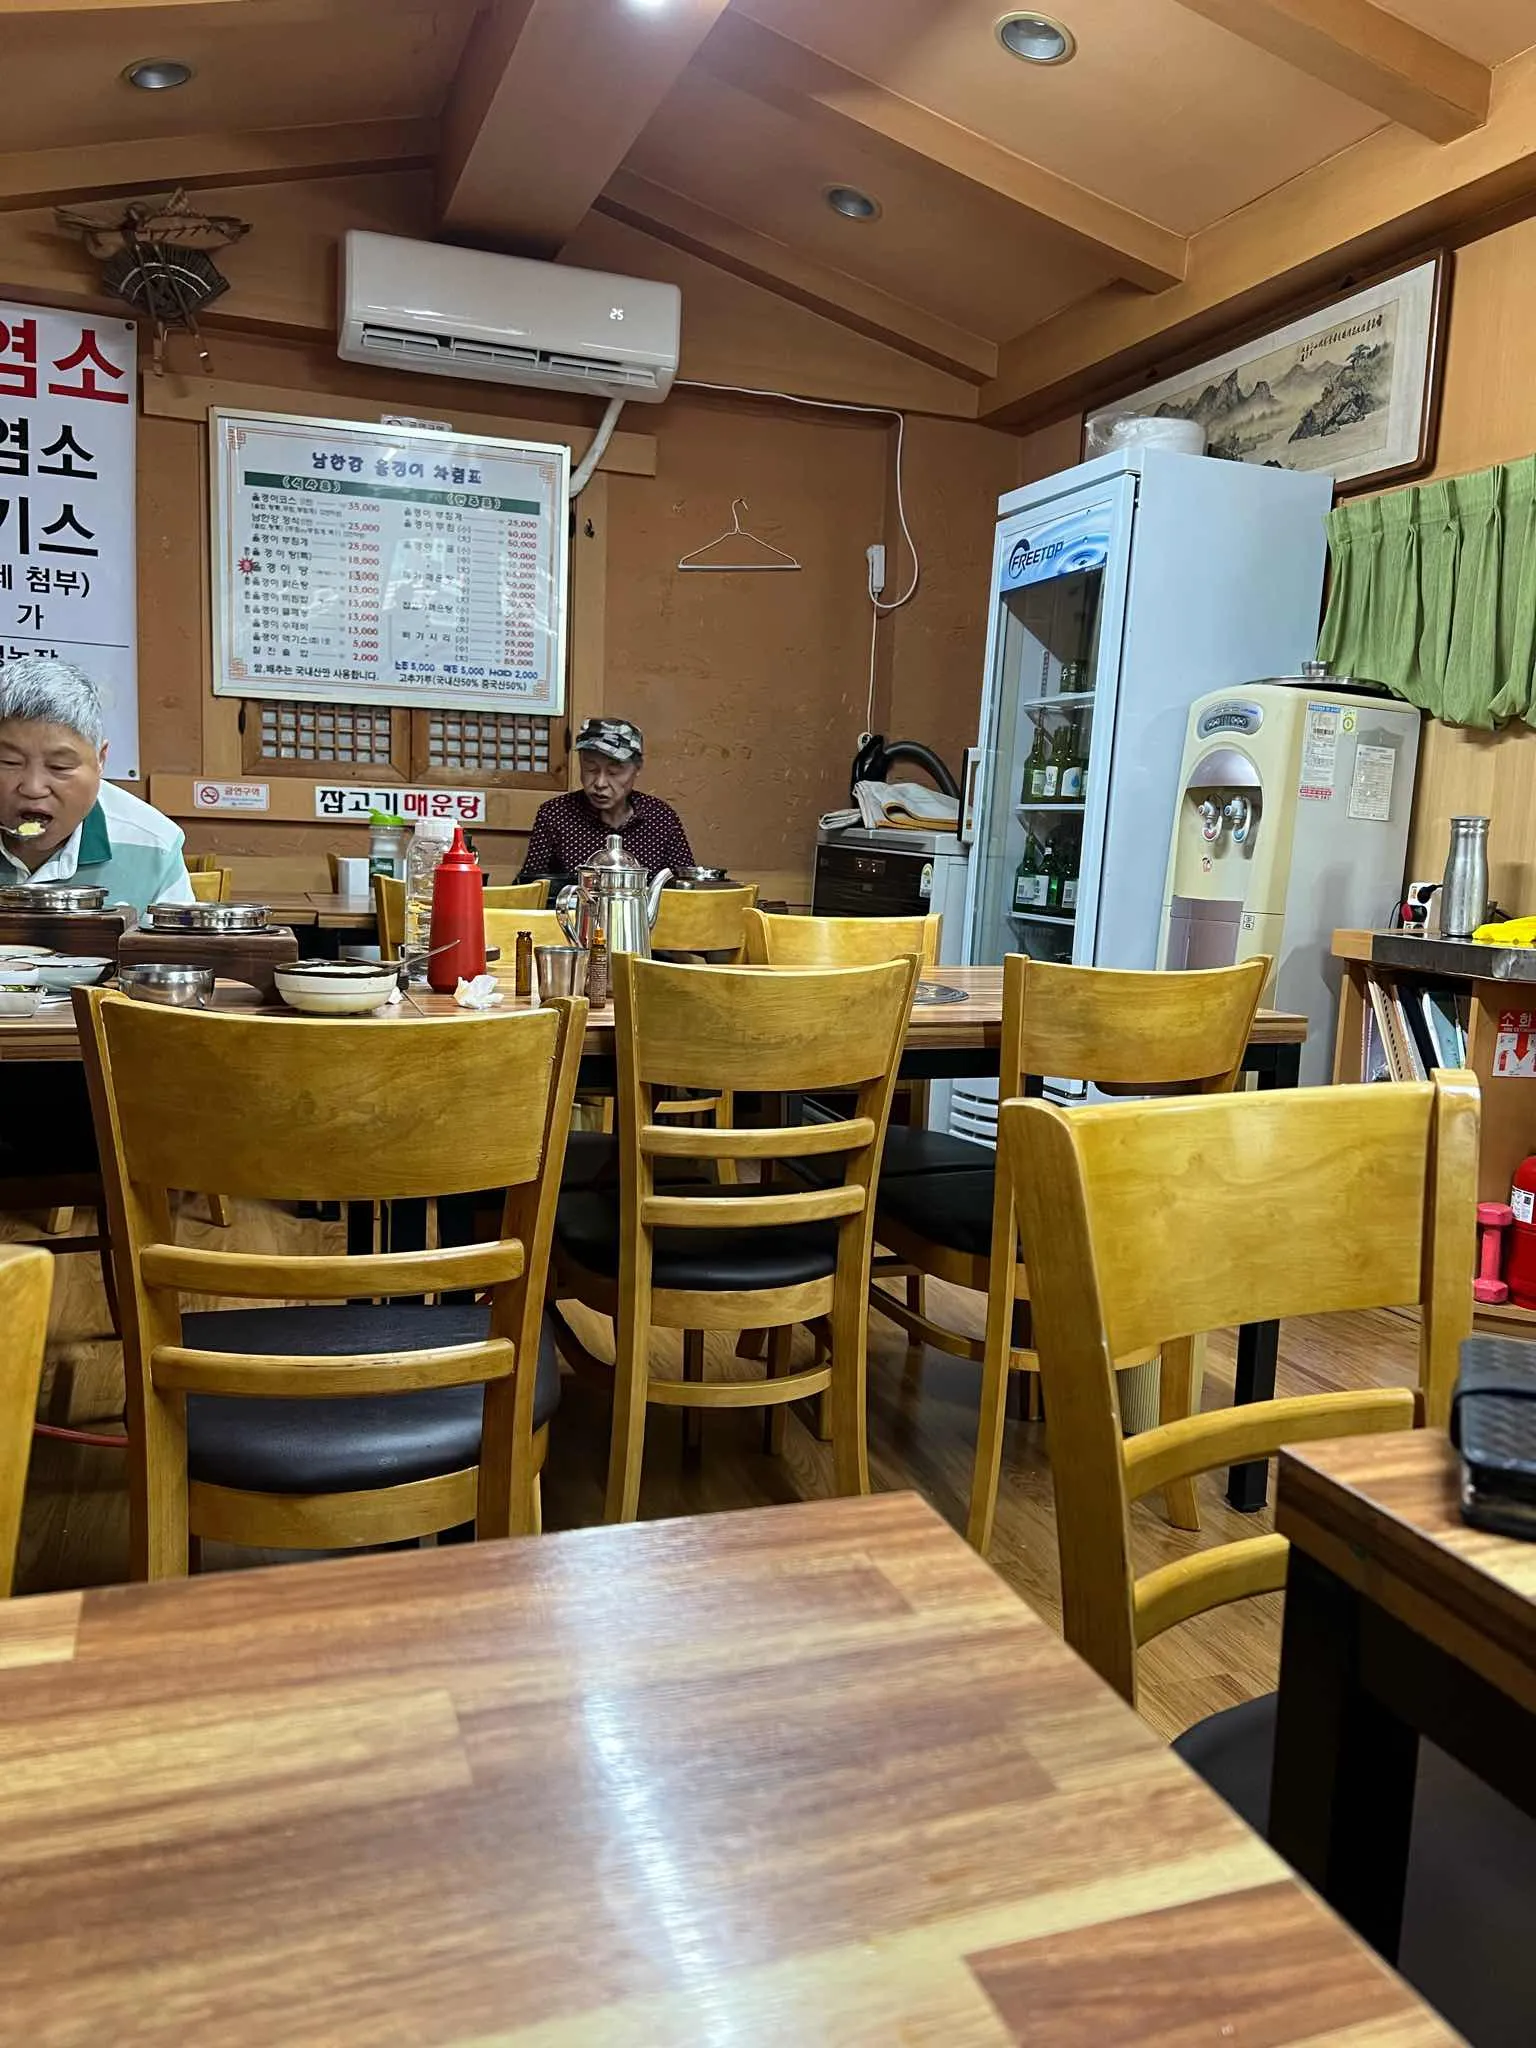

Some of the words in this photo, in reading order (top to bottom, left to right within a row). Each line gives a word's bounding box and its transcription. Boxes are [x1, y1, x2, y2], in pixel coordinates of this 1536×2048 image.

[609, 307, 624, 320] 25
[312, 451, 364, 473] 남한강
[433, 464, 482, 484] 차림표
[1010, 541, 1064, 572] FREETOP
[25, 565, 90, 598] 첨부)
[16, 604, 44, 630] 가
[352, 639, 379, 649] 5,000
[352, 653, 379, 662] 2,000
[295, 665, 331, 678] 국내산만
[332, 669, 379, 681] 사용합니다.
[514, 669, 538, 679] 2,000
